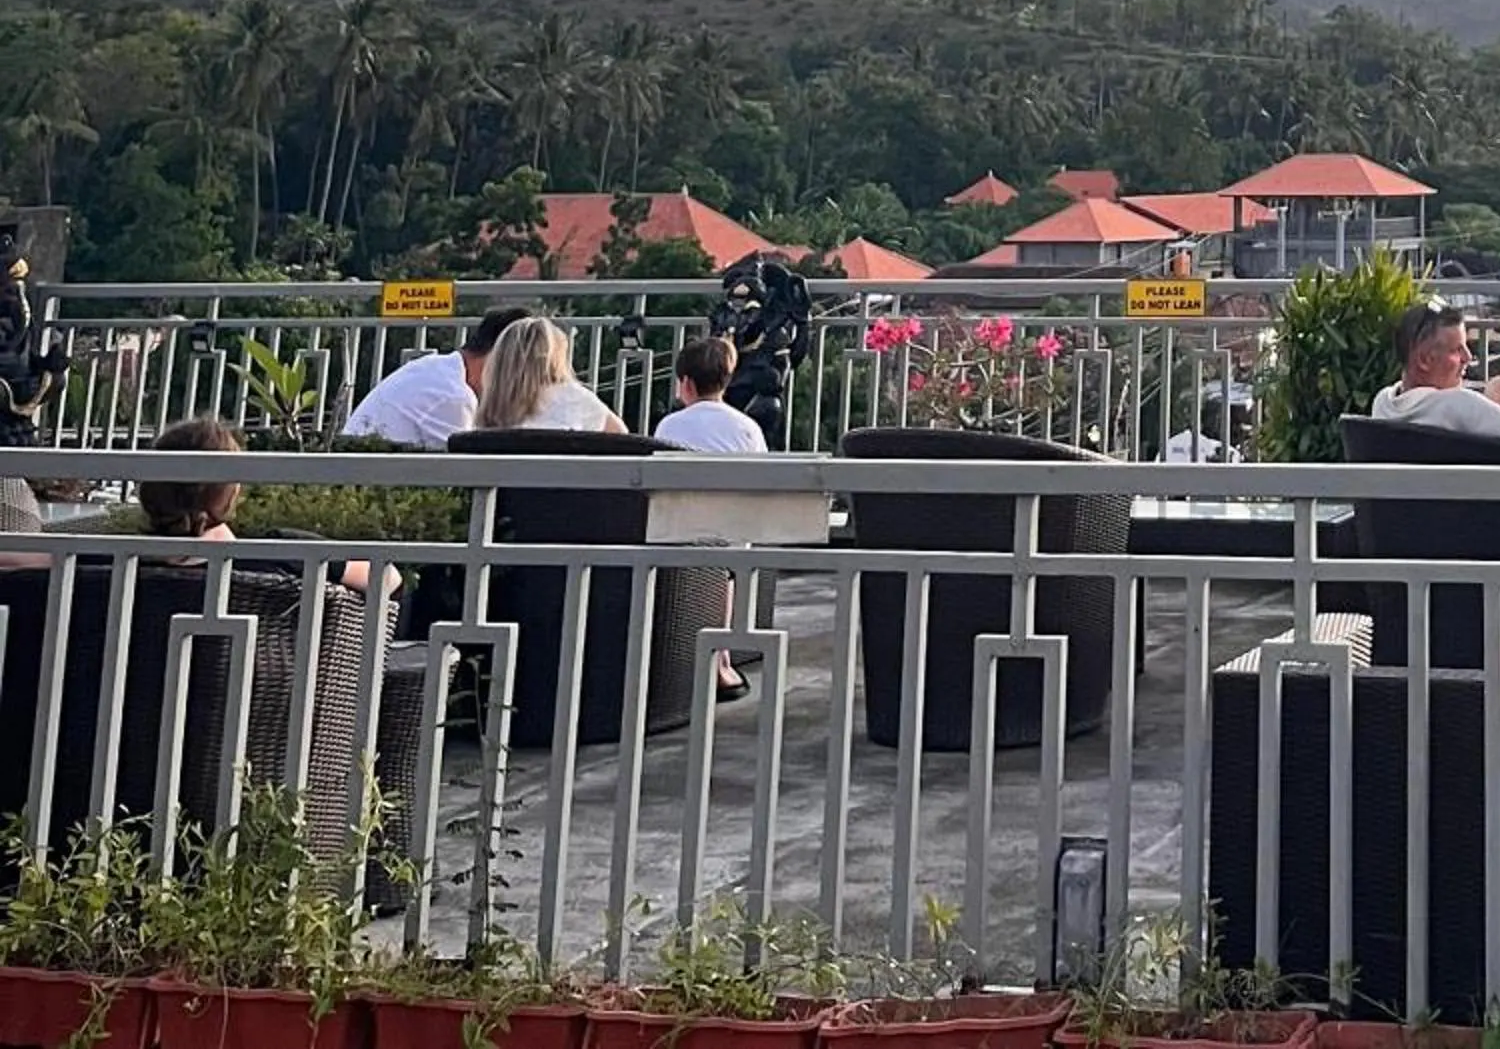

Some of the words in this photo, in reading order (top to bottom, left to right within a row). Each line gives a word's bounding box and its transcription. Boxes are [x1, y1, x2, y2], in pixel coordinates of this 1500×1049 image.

[400, 288, 436, 297] PLEASE
[1145, 286, 1185, 296] PLEASE
[1131, 300, 1145, 310] DO
[1148, 300, 1170, 310] NOT
[1173, 300, 1201, 310] LEAN
